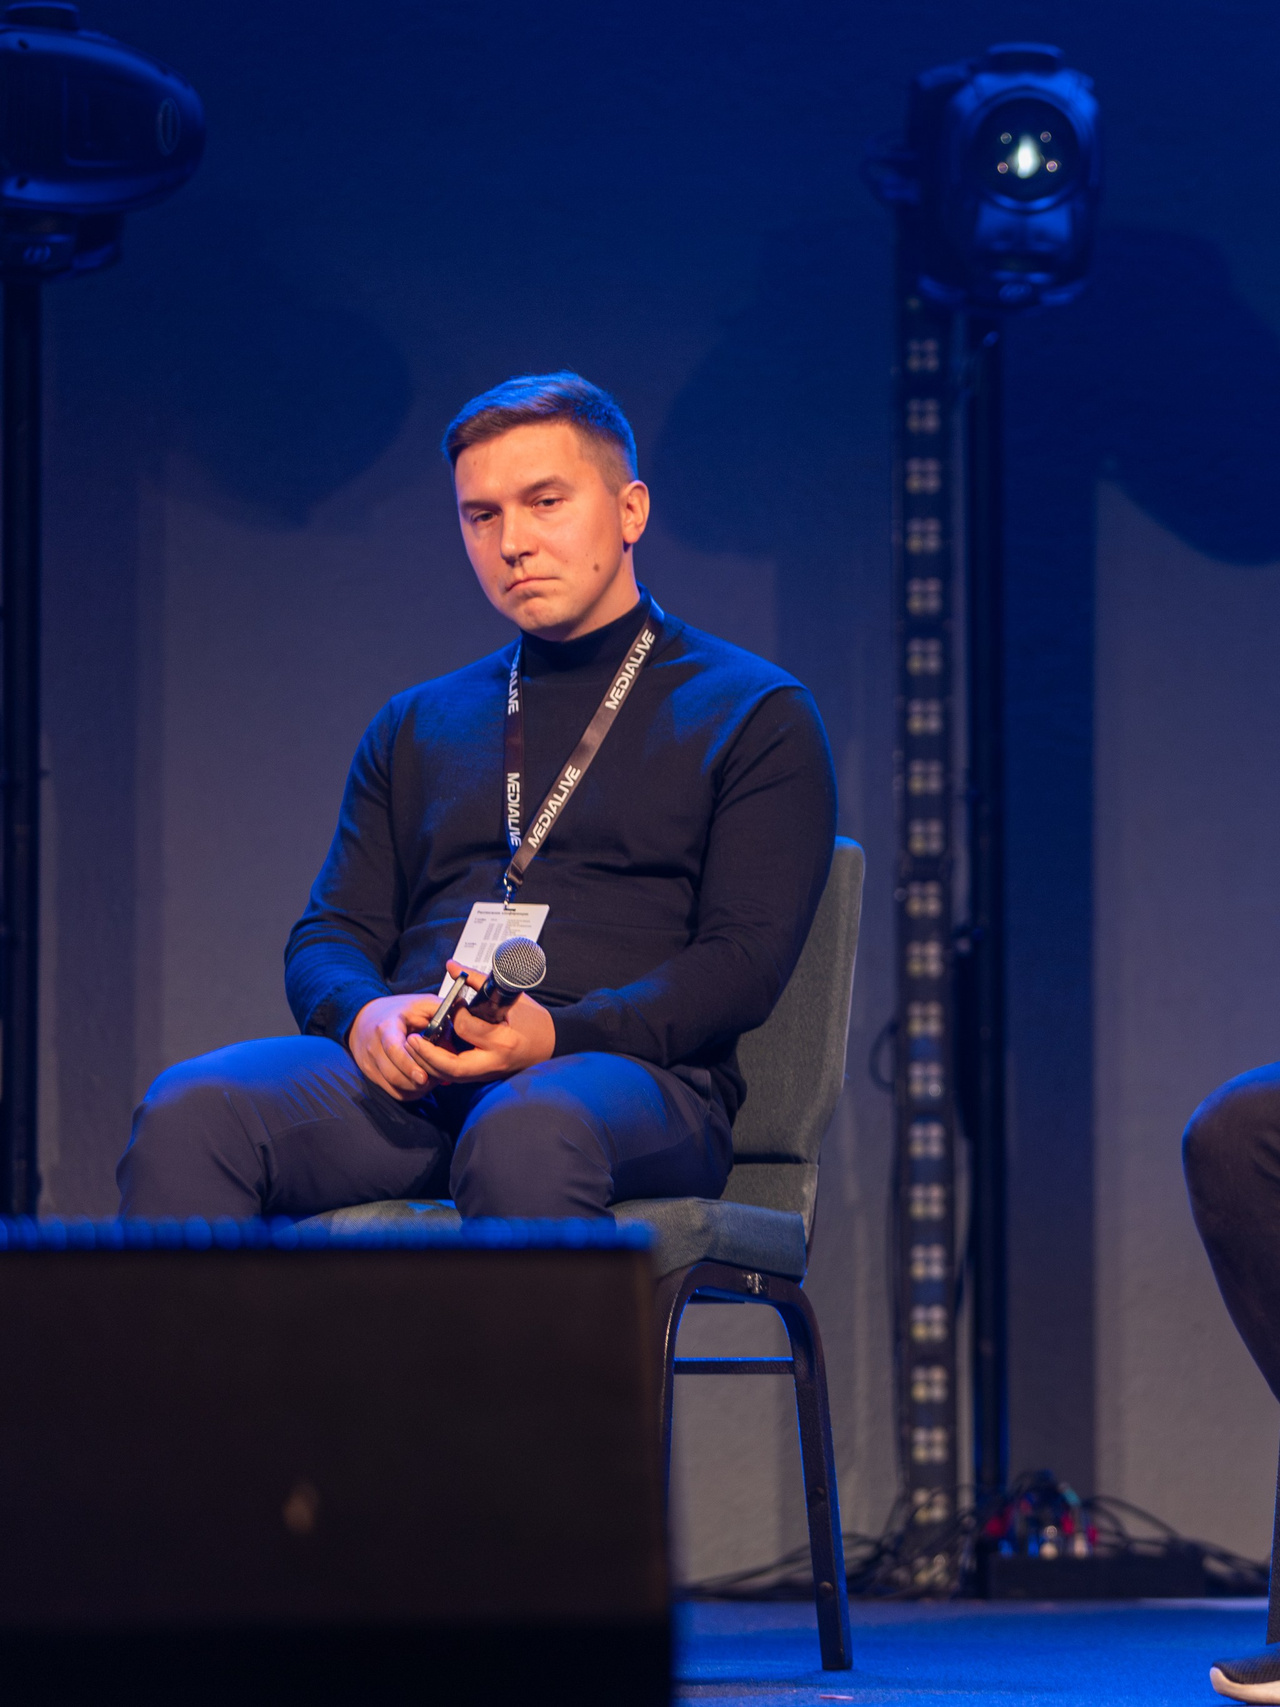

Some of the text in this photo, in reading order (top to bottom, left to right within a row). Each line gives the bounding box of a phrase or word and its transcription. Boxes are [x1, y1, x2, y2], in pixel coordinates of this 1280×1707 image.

[605, 629, 656, 711] MEDIALIVE
[507, 772, 522, 848] MEDIALIVE
[528, 765, 581, 849] MEDIALIVE
